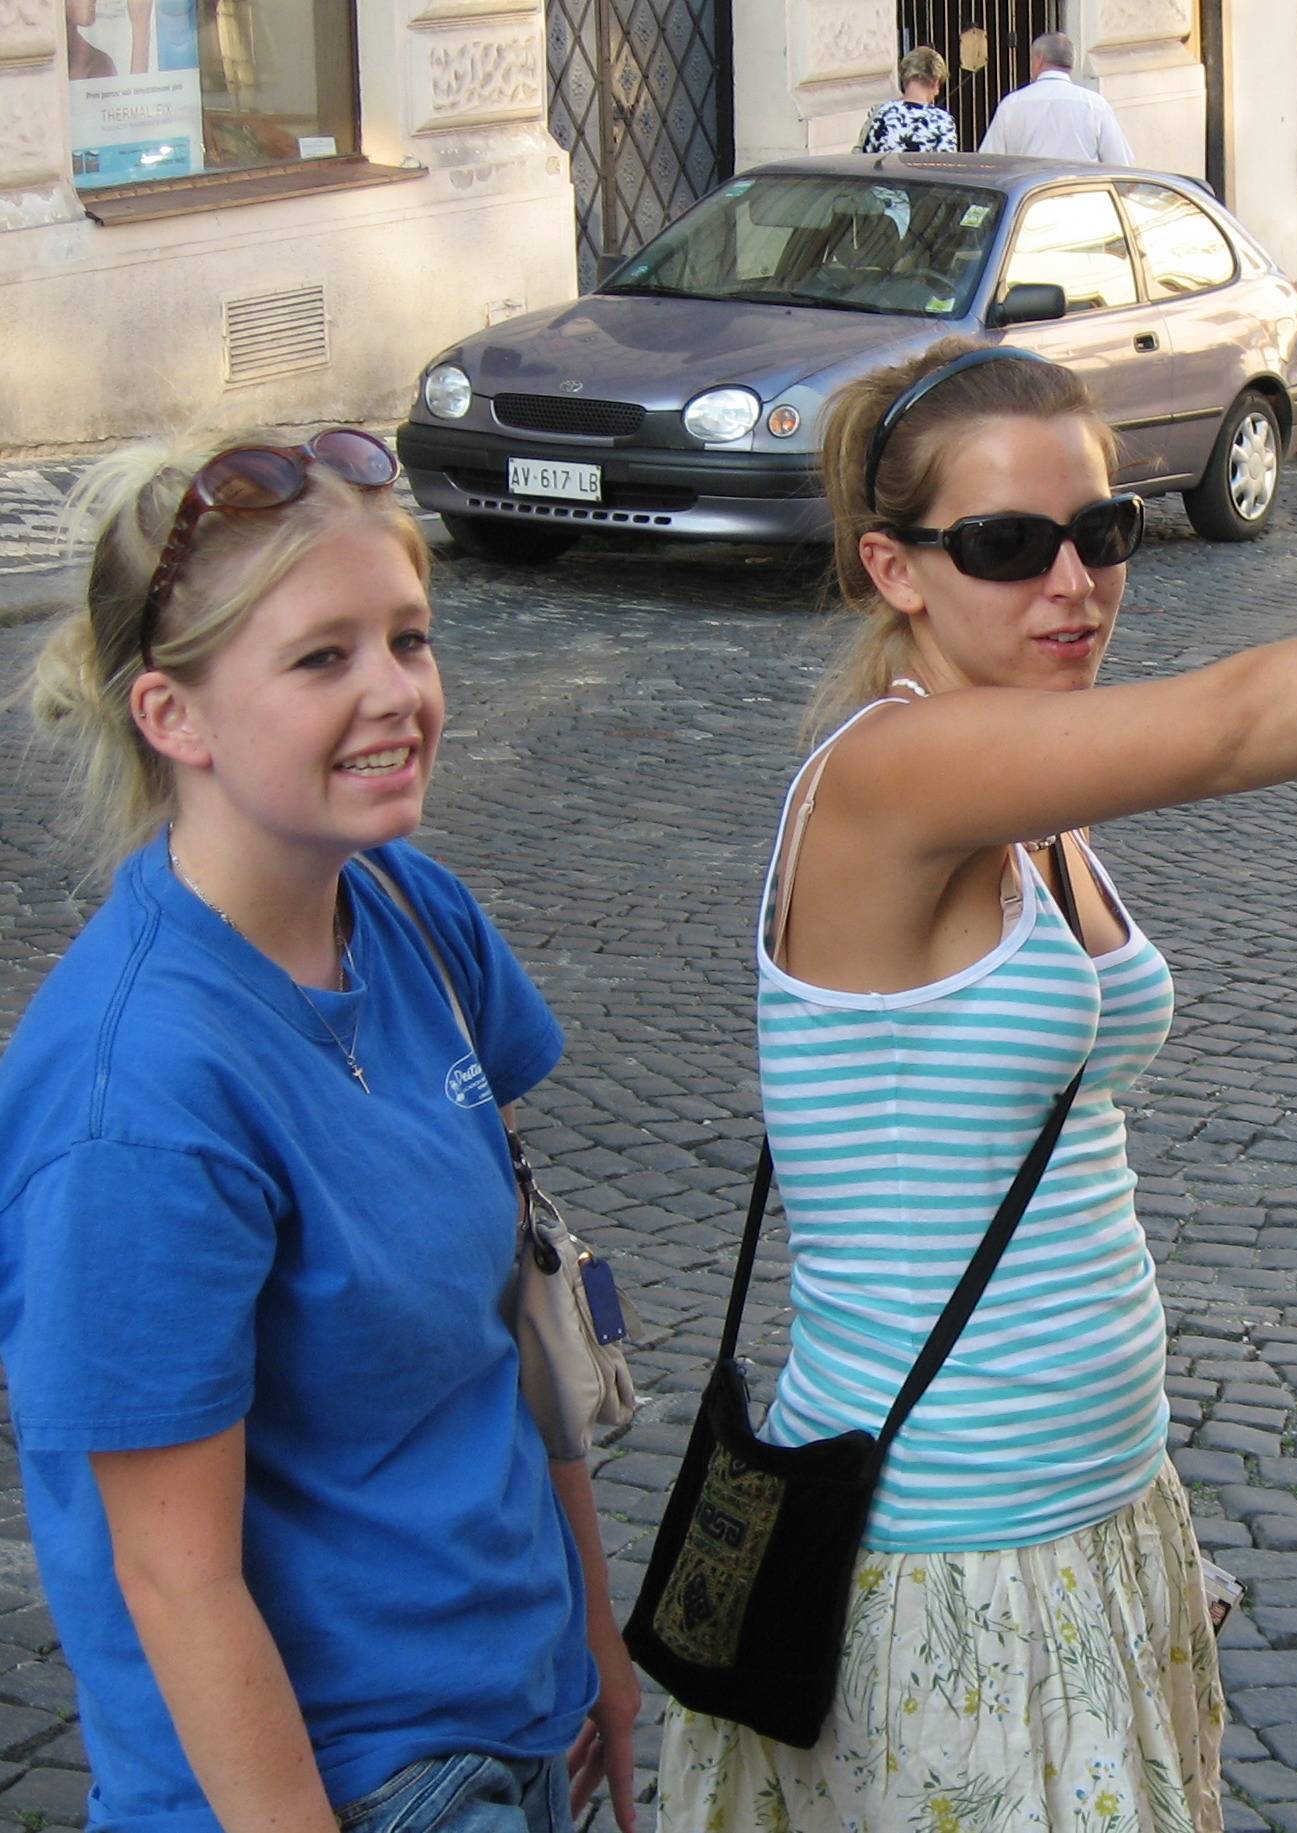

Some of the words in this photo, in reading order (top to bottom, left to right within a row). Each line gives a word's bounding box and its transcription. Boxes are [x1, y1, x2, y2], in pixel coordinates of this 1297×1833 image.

[101, 105, 153, 121] THERMAL
[511, 465, 530, 487] AV
[540, 468, 570, 490] 617
[578, 471, 599, 493] LB
